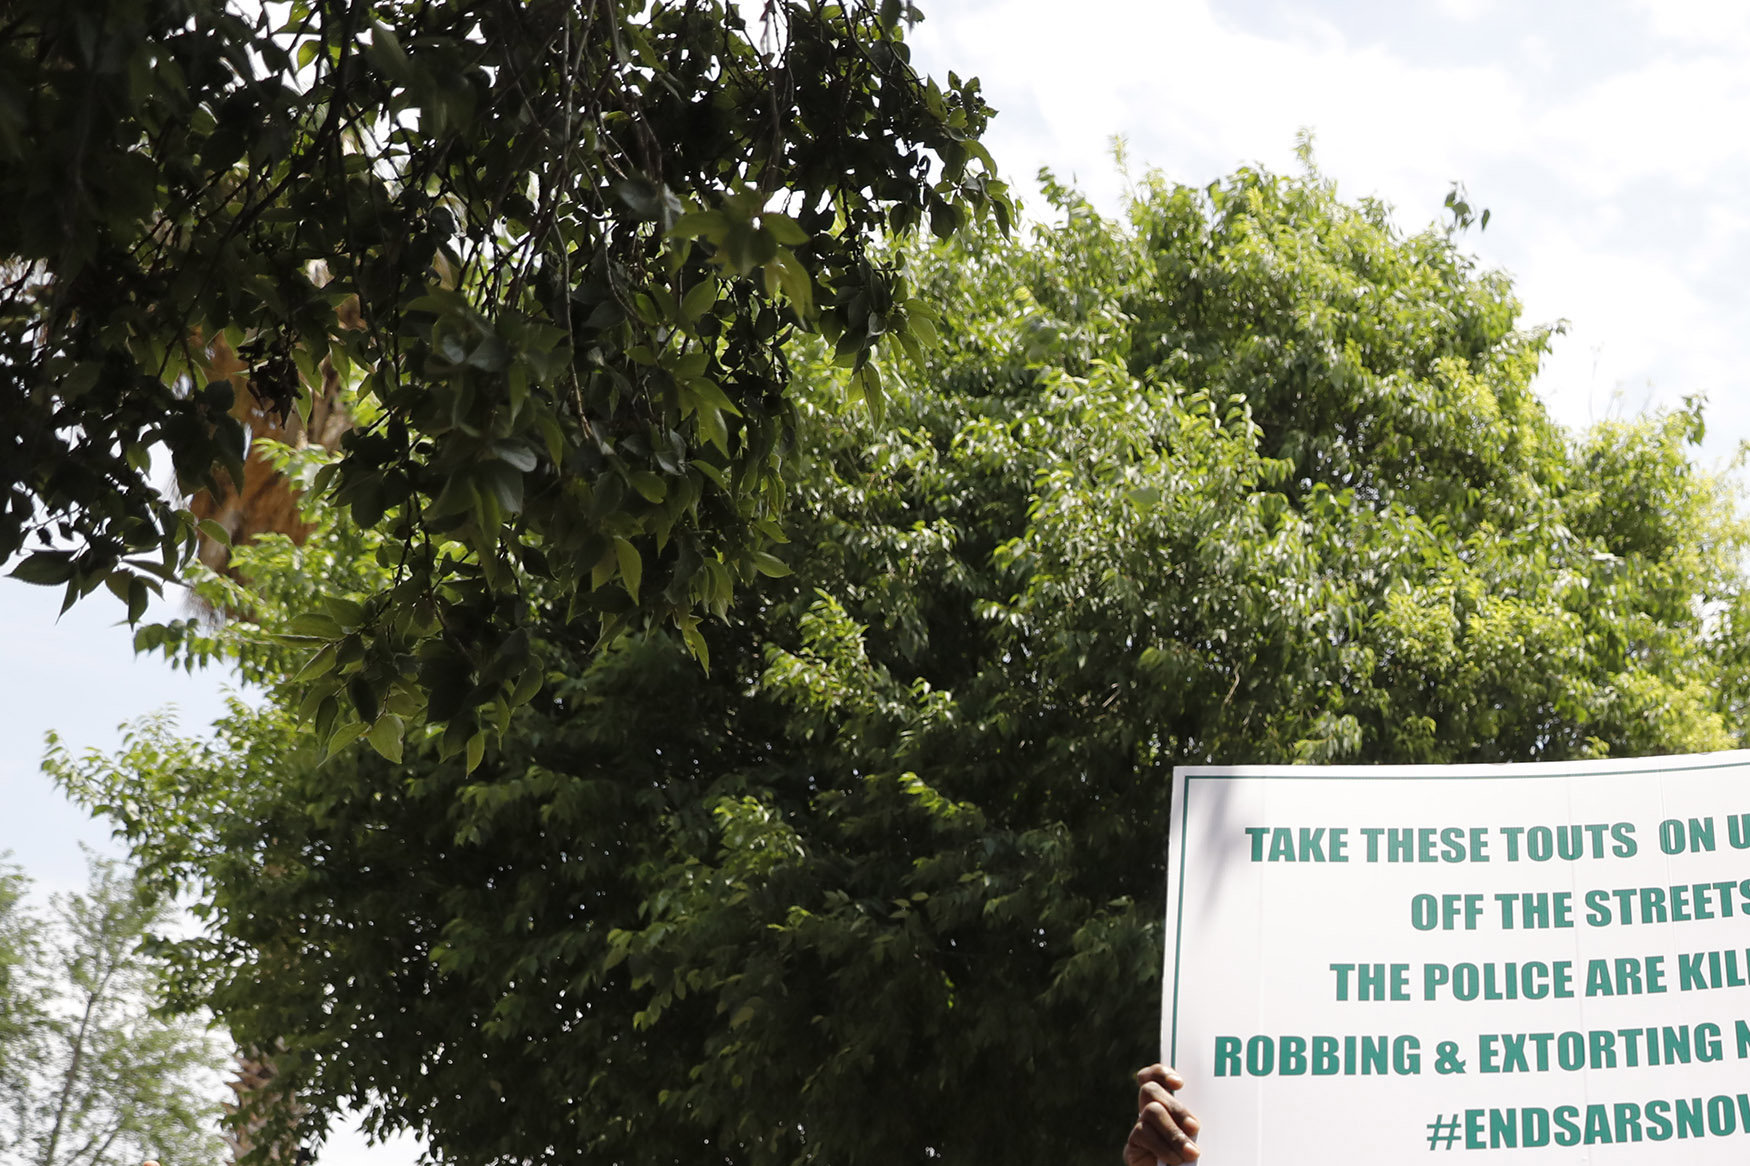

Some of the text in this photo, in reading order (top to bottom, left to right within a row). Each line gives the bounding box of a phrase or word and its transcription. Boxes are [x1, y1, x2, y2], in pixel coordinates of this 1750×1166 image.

[1246, 827, 1349, 863] TAKE
[1363, 826, 1489, 863] THESE
[1500, 821, 1638, 861] TOUTS
[1660, 818, 1715, 855] ON
[1411, 893, 1483, 931] OFF
[1494, 892, 1575, 930] THE
[1329, 963, 1410, 1002] THE
[1424, 960, 1575, 1002] POLICE
[1585, 955, 1667, 998] ARE
[1214, 1034, 1421, 1078] ROBBING
[1434, 1041, 1466, 1075] &
[1478, 1025, 1724, 1074] EXTORTING
